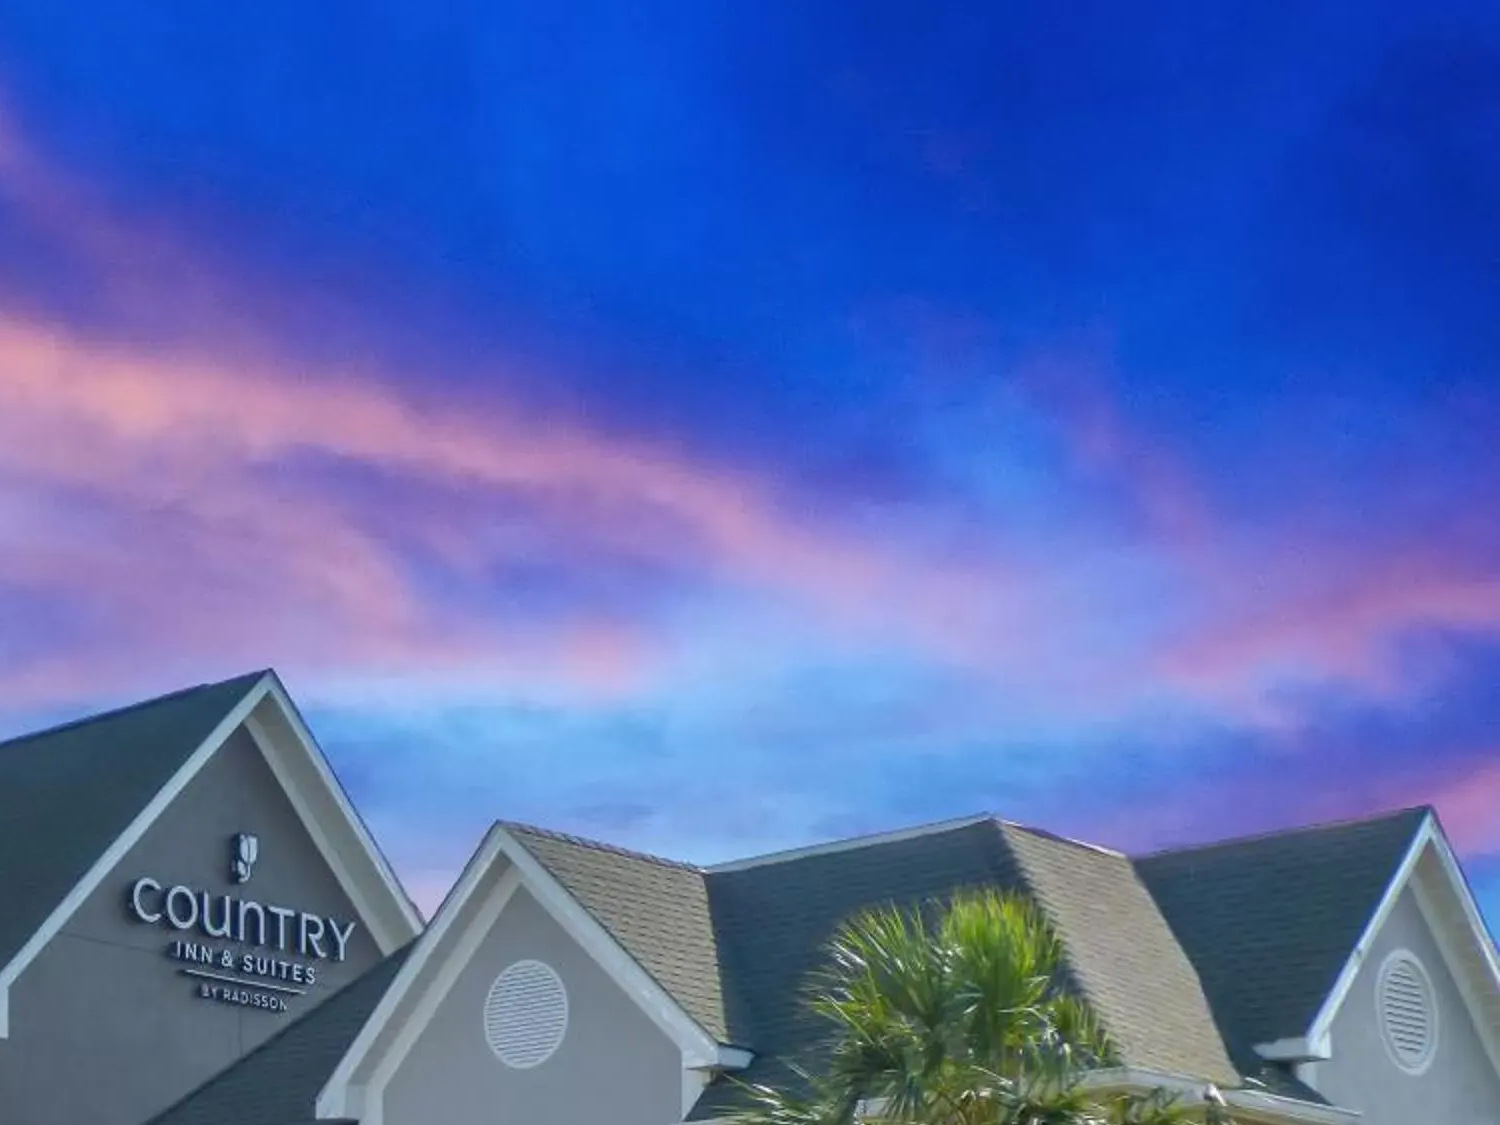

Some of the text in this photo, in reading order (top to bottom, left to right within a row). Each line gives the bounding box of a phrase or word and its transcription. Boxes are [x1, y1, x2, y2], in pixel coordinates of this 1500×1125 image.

[175, 940, 317, 985] INN & SUITES
[223, 988, 288, 1011] RADISSON
